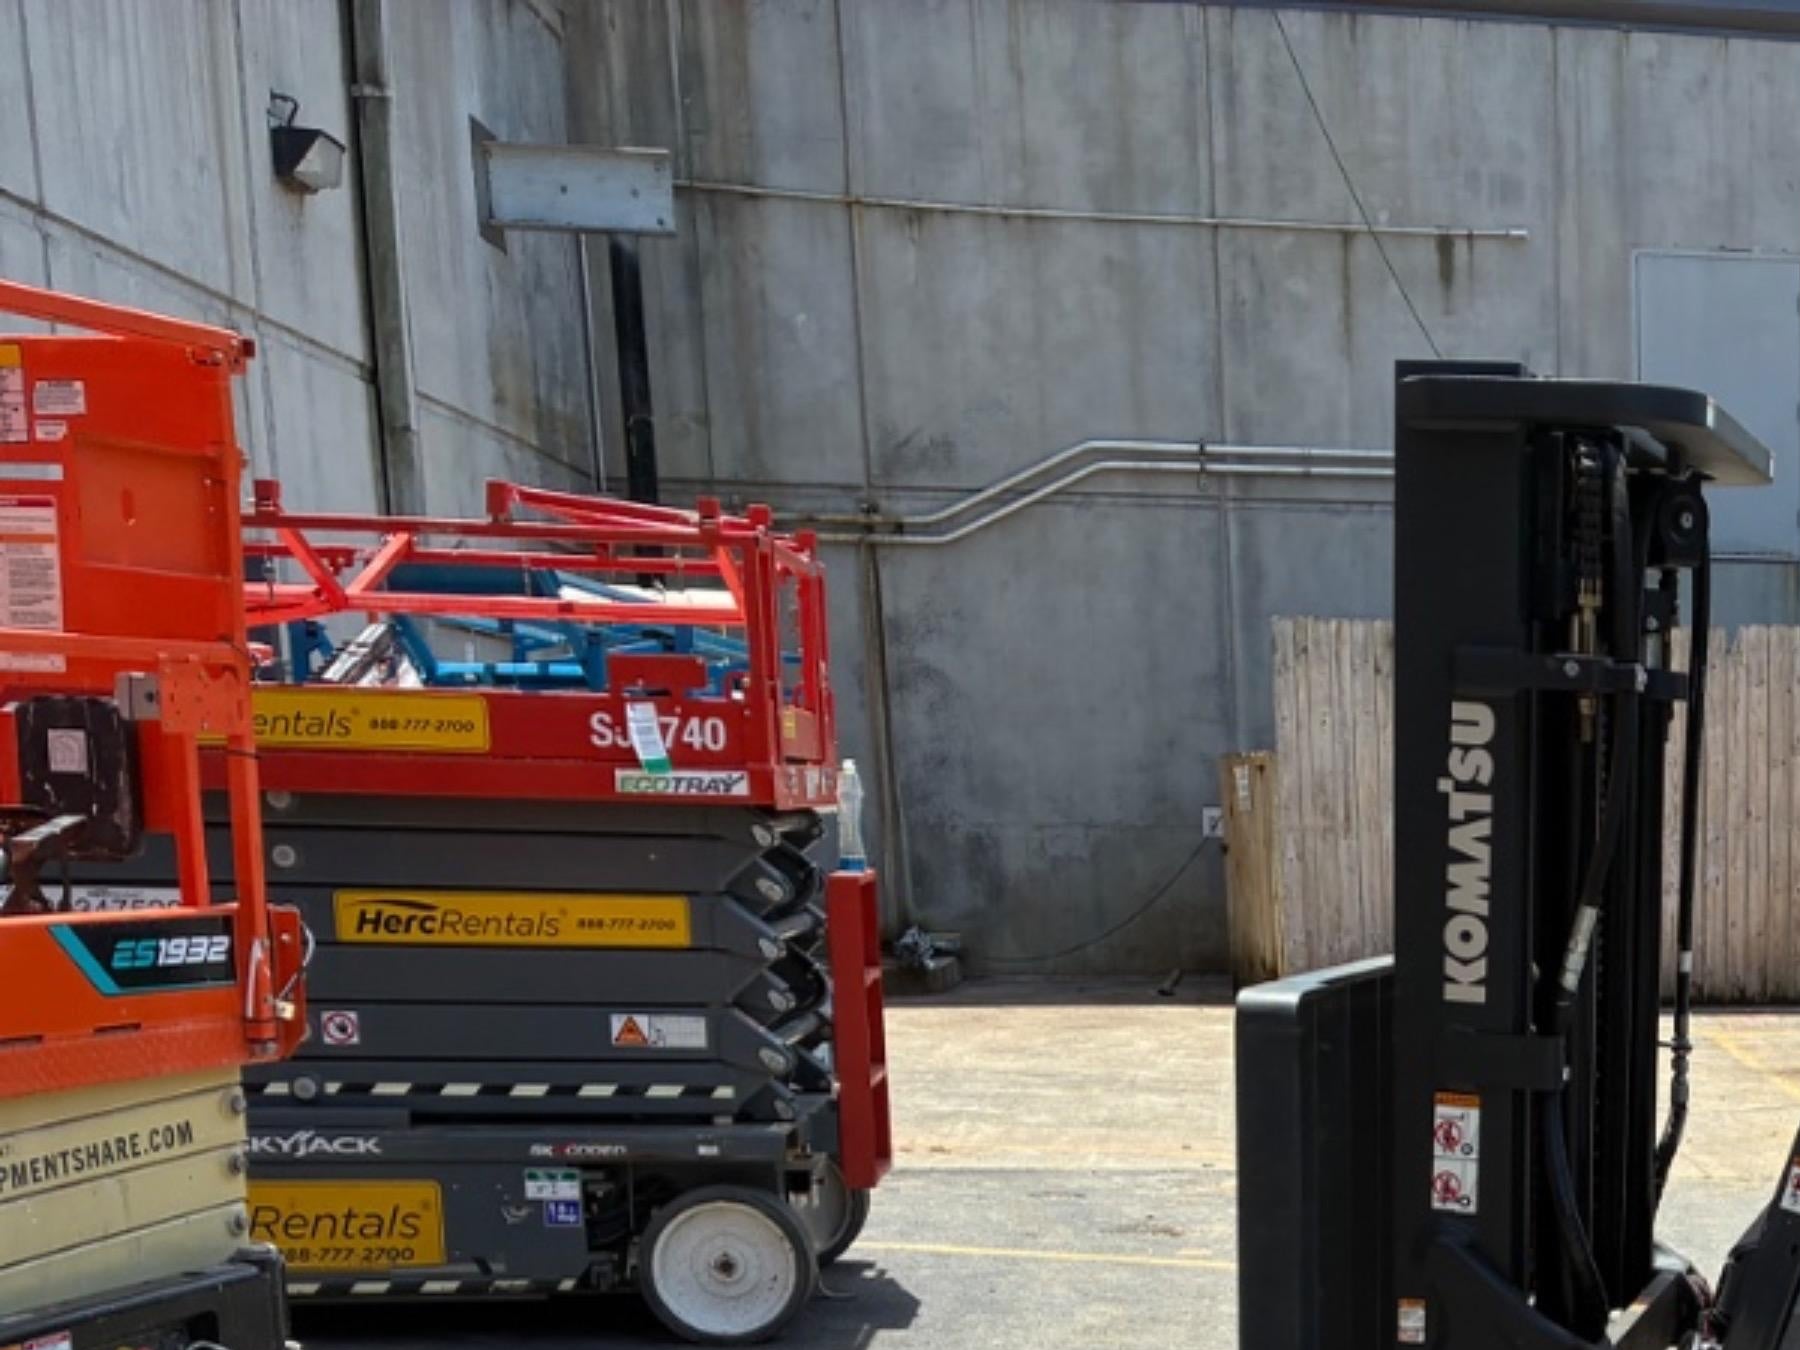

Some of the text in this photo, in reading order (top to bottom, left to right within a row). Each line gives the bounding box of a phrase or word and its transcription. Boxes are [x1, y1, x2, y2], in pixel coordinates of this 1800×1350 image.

[620, 774, 745, 793] ECOTRAY
[1437, 701, 1496, 1003] KOMATSU
[356, 907, 677, 937] HercRentals 888-777-2700
[111, 936, 231, 969] ES1932
[250, 1204, 421, 1240] Rentals
[281, 1247, 416, 1262] 88-777-2700
